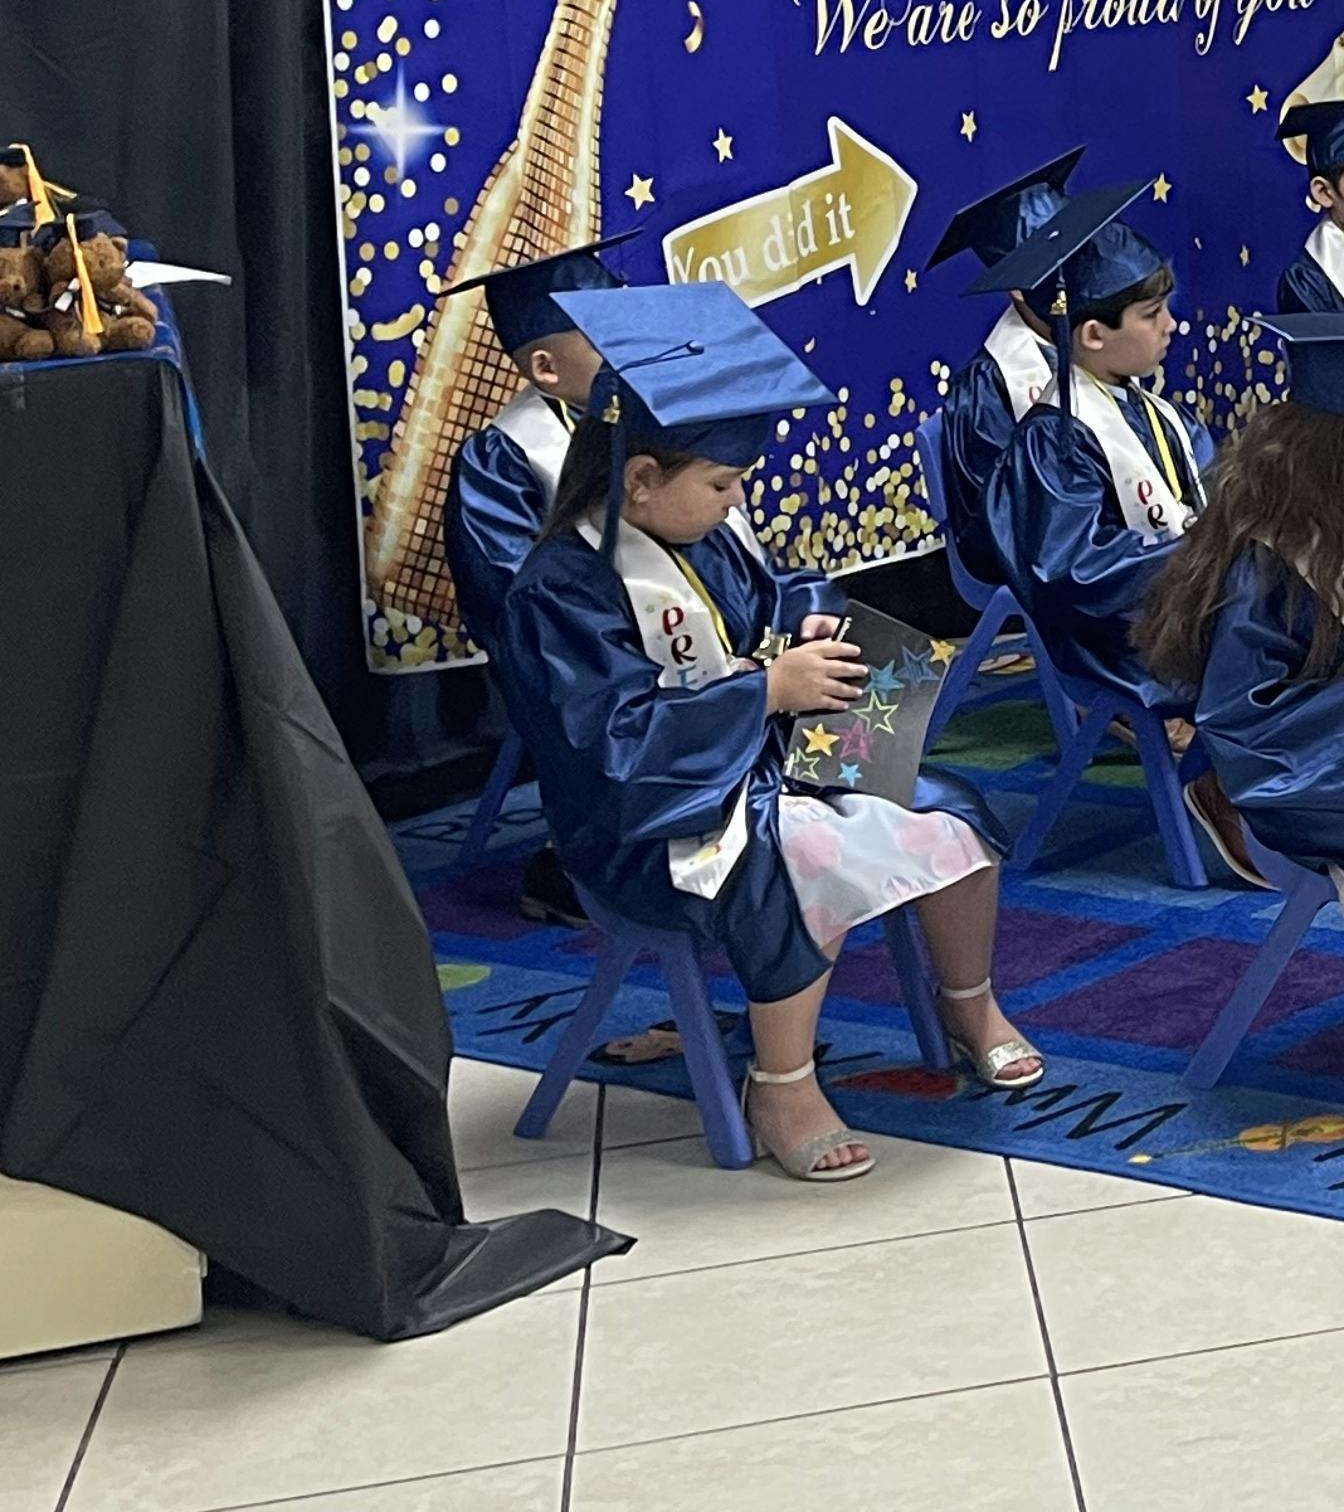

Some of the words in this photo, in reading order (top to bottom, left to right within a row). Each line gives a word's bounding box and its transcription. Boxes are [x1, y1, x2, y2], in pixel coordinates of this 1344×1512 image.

[907, 0, 982, 47] are
[762, 199, 819, 272] did
[825, 192, 856, 246] it
